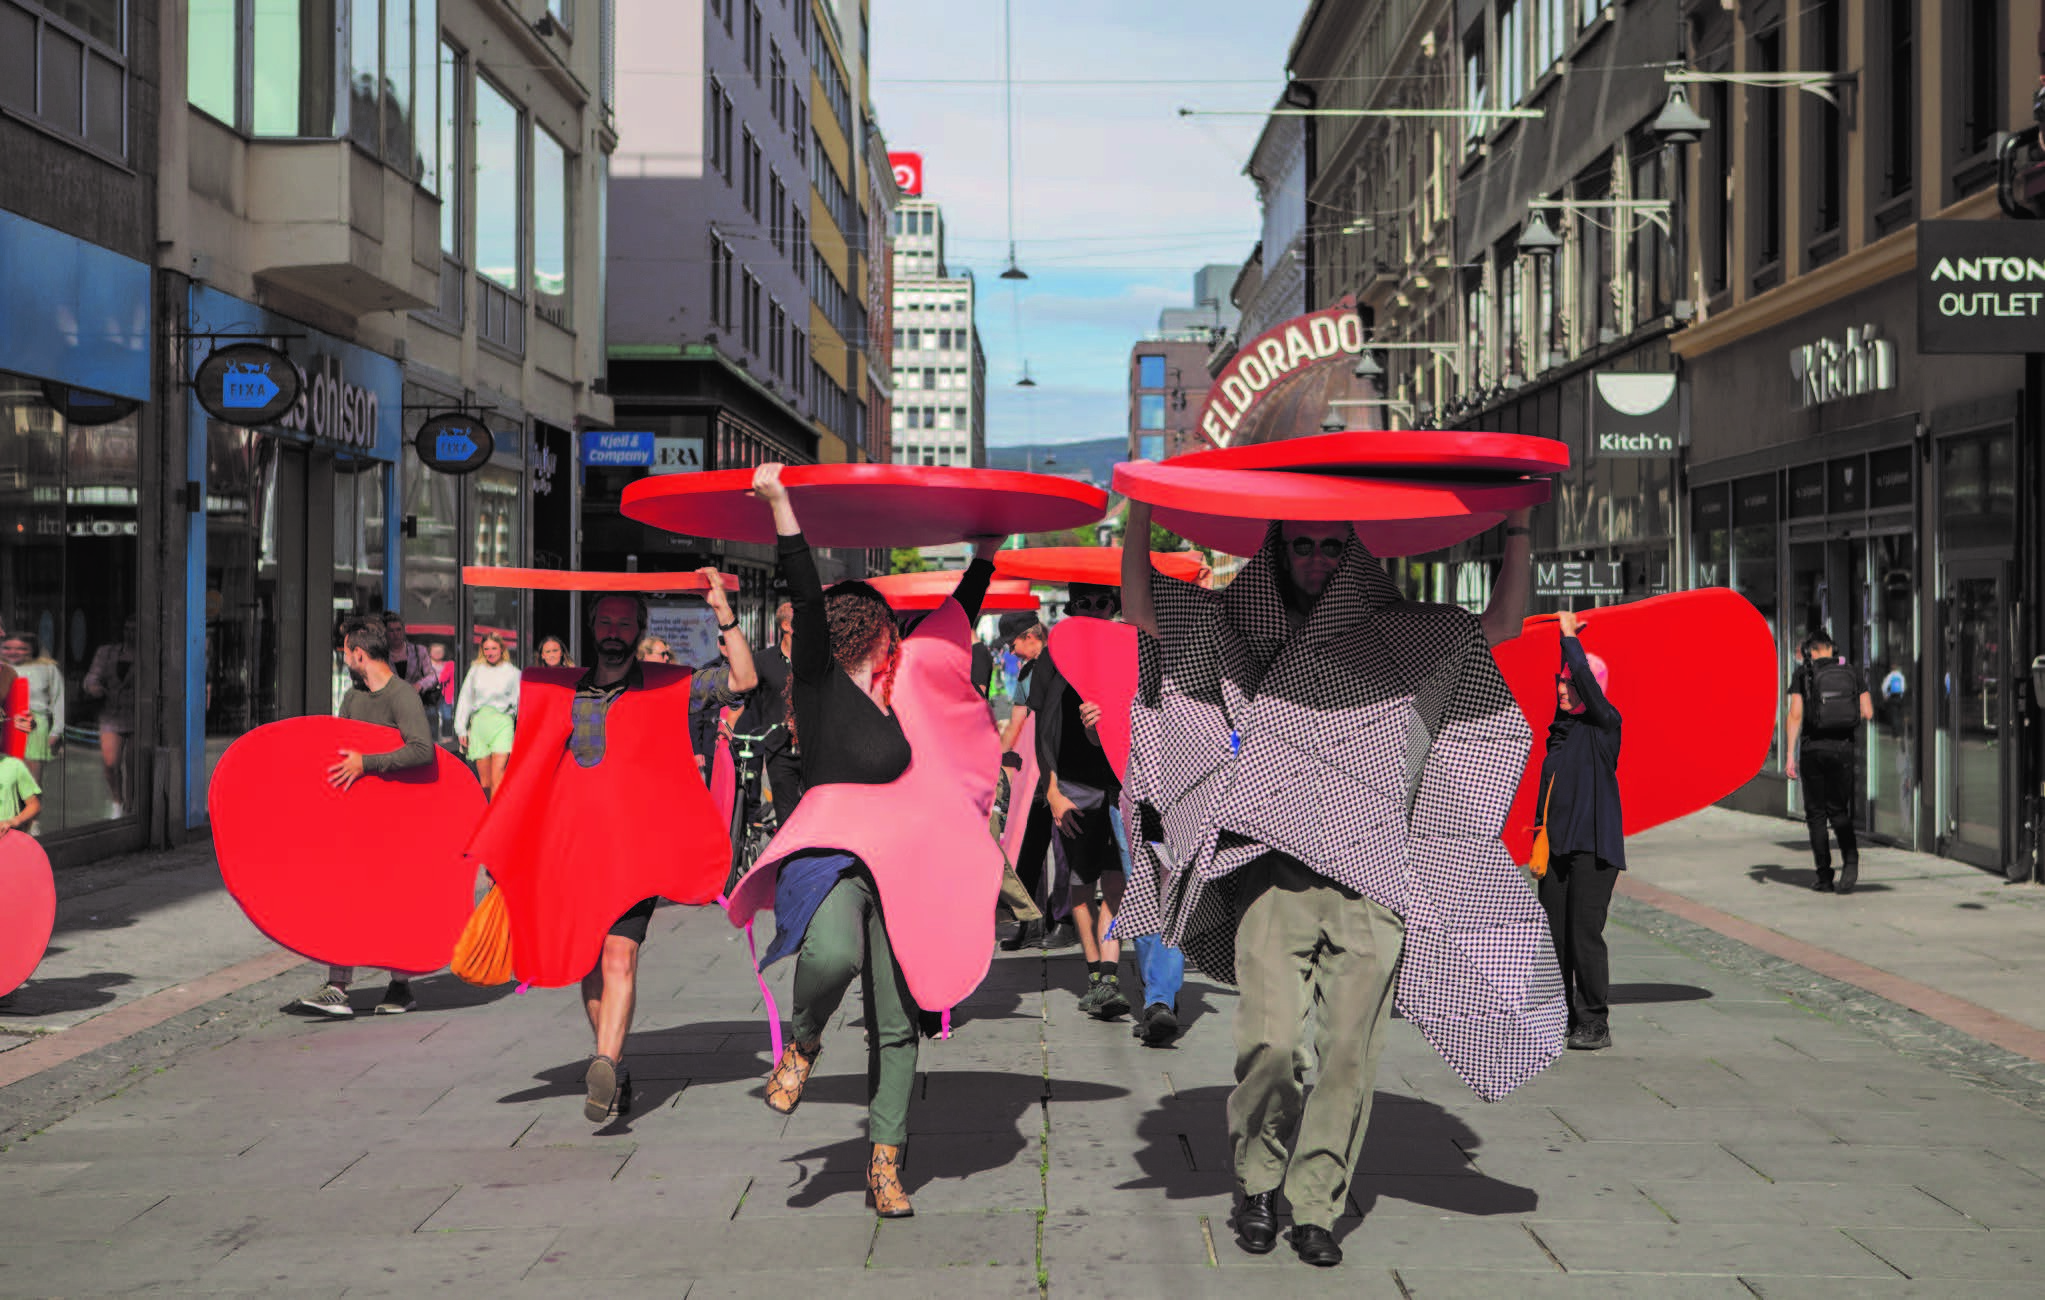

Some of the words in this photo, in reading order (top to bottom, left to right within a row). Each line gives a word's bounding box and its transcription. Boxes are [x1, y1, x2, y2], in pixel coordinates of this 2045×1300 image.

[1930, 256, 2045, 282] ANTON
[1939, 292, 2043, 316] OUTLET
[230, 383, 266, 398] FIXA
[1202, 313, 1363, 449] ELDORADO
[313, 354, 379, 448] ohlson
[600, 434, 629, 448] Kjell
[630, 434, 640, 447] &
[1599, 432, 1673, 451] Kitch'n
[589, 449, 649, 463] Company
[1537, 562, 1621, 587] MELT
